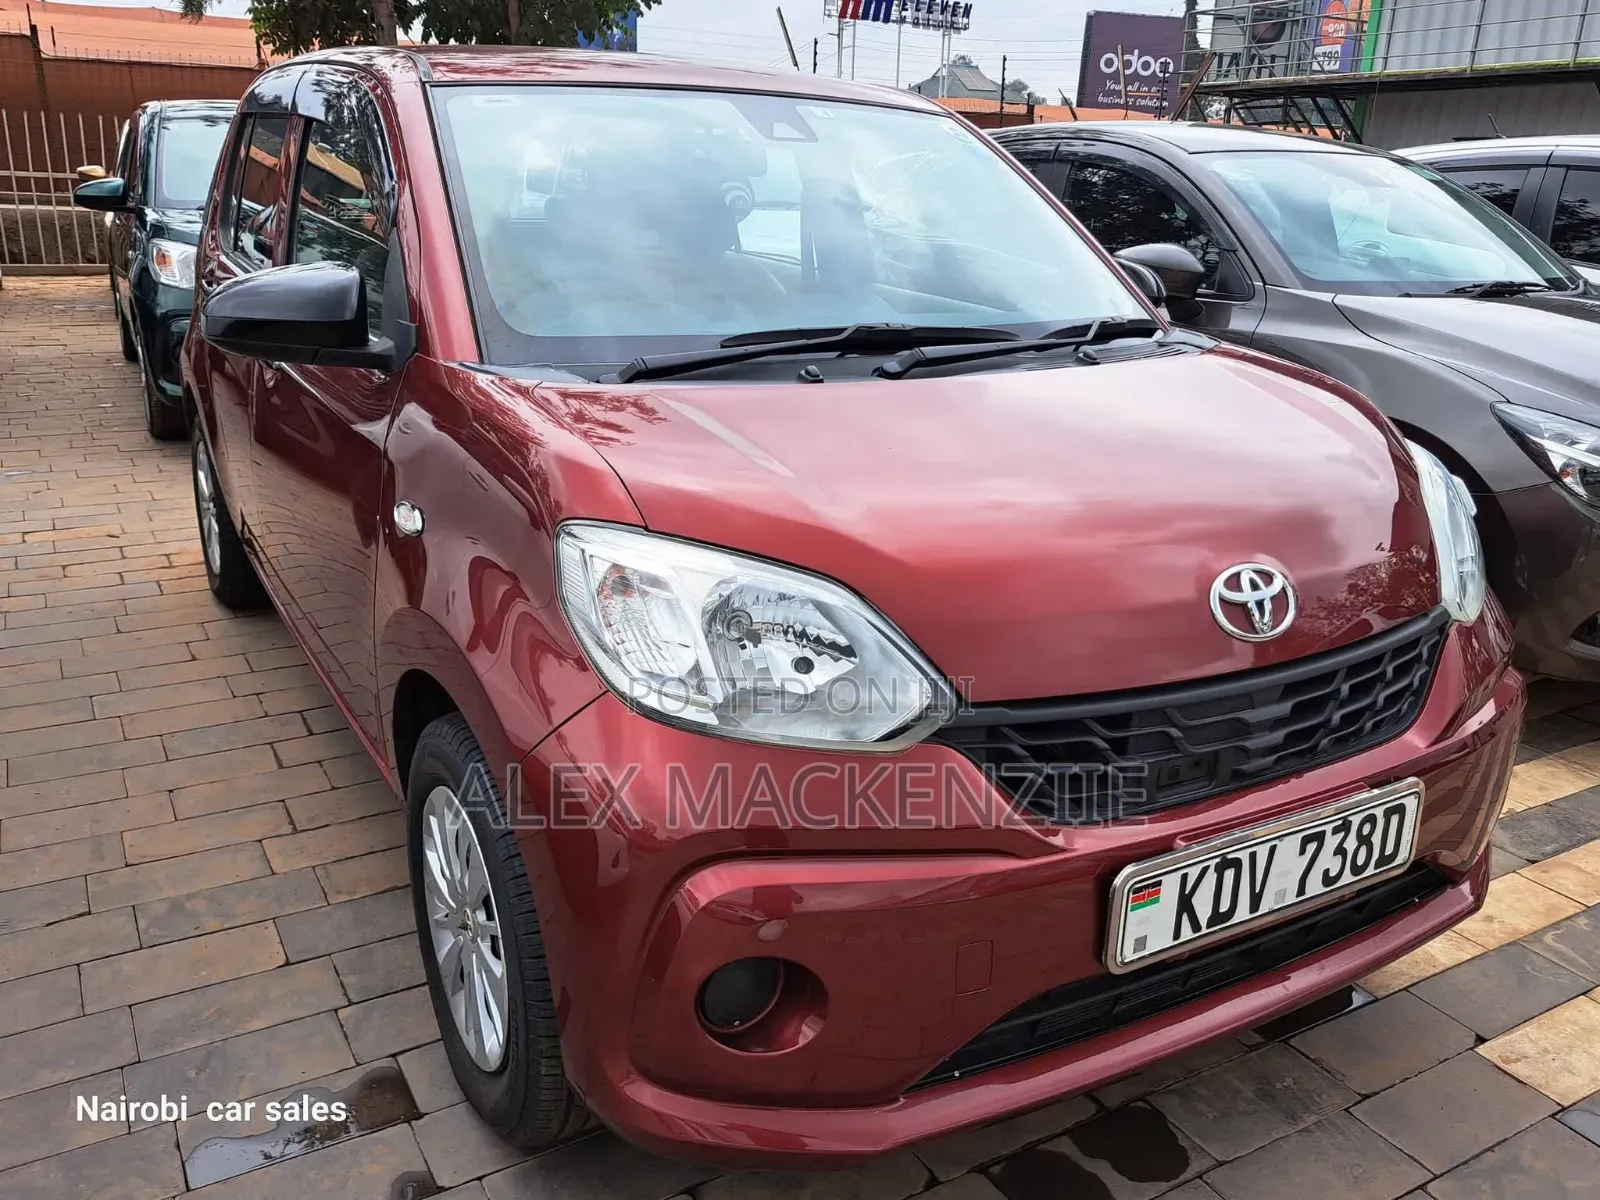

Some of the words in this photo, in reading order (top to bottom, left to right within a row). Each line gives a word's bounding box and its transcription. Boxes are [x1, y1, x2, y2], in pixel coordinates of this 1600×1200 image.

[900, 0, 973, 19] ELEVEN
[1100, 49, 1174, 77] odoo
[1105, 79, 1124, 91] You
[1126, 81, 1140, 92] all
[1139, 83, 1149, 92] in
[1172, 844, 1277, 941] KDV
[1296, 803, 1407, 898] 738D
